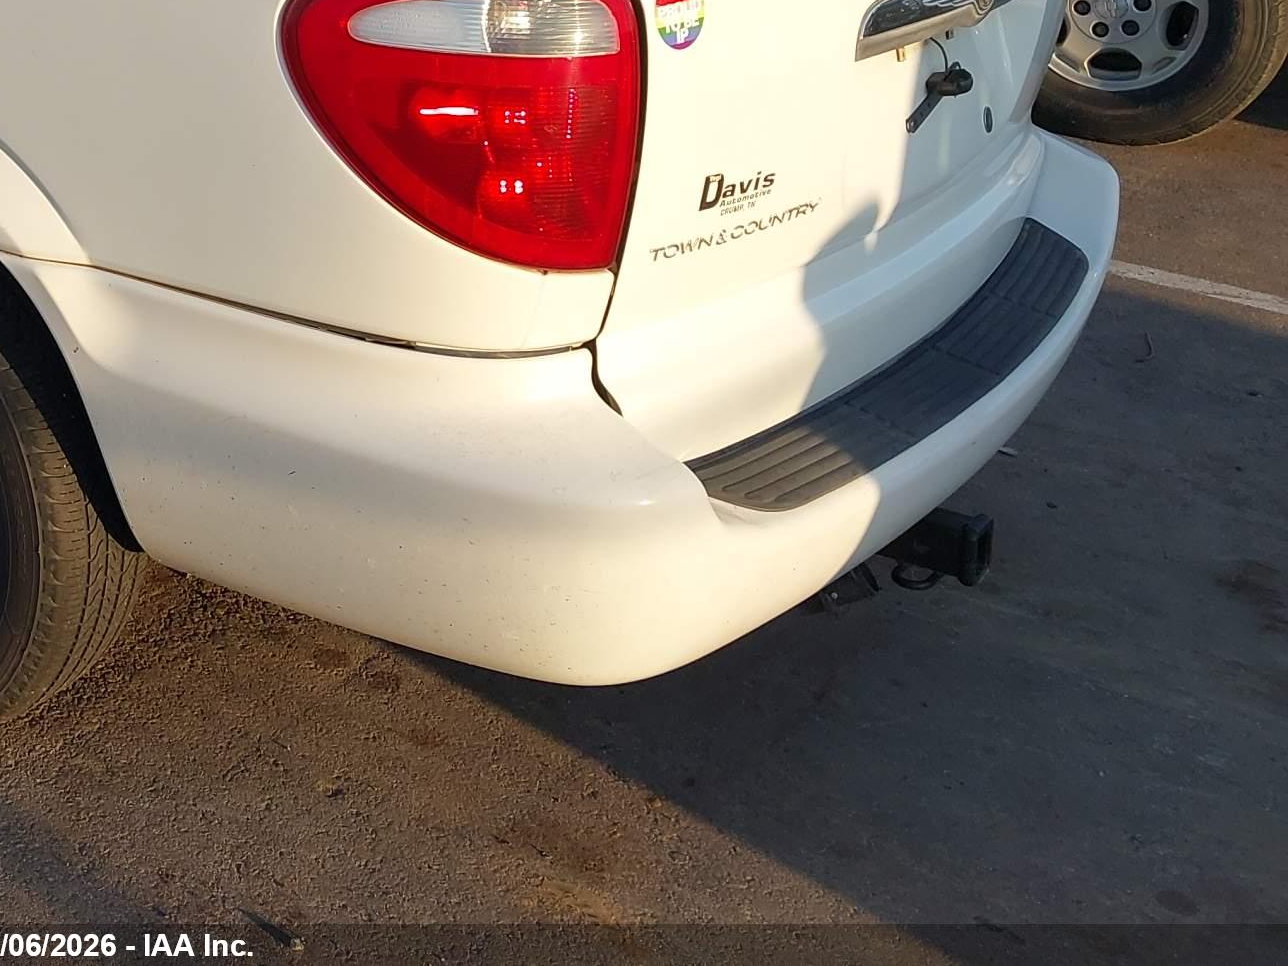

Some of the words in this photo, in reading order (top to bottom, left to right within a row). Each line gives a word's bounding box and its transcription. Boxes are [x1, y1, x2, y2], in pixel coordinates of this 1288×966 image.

[658, 0, 701, 20] PROUD
[698, 170, 776, 212] Davis
[719, 187, 772, 208] Automotive
